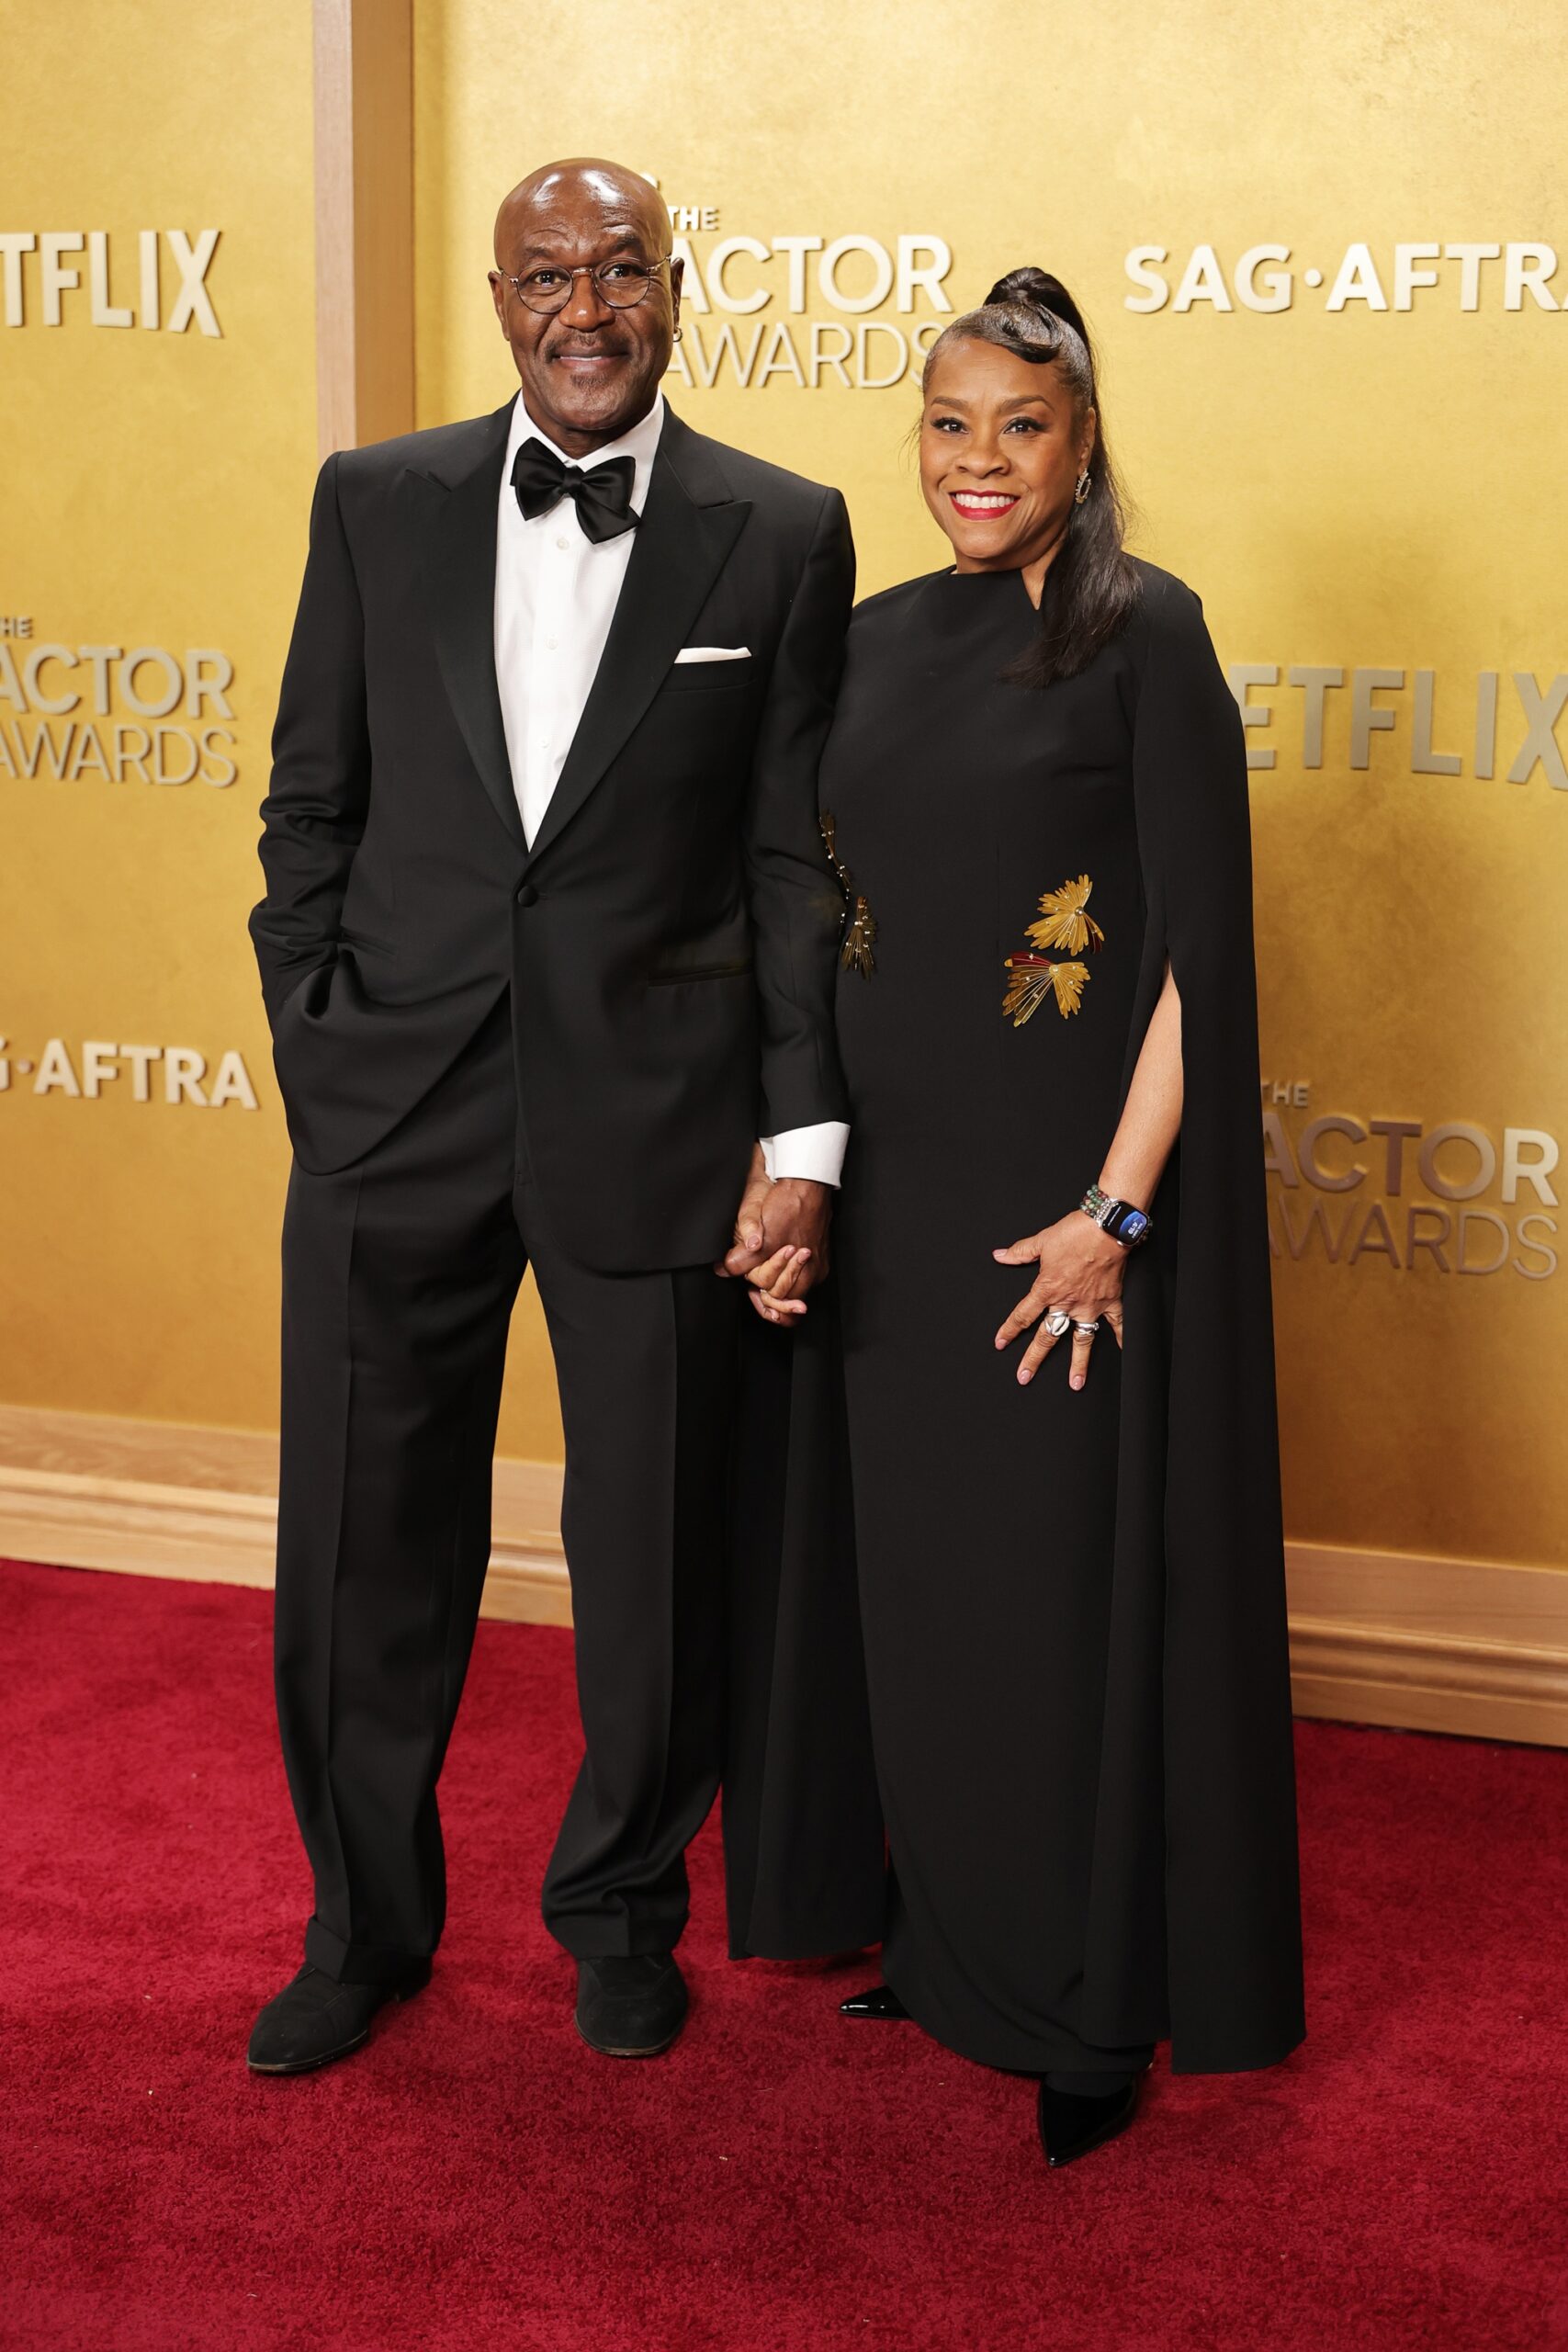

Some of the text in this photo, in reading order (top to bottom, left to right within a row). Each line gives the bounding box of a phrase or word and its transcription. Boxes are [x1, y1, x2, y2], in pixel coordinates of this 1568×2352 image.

[671, 234, 953, 314] ACTOR
[1124, 243, 1568, 313] SAG·AFTR
[1261, 1080, 1309, 1108] HE
[1269, 1196, 1558, 1281] WARDS
